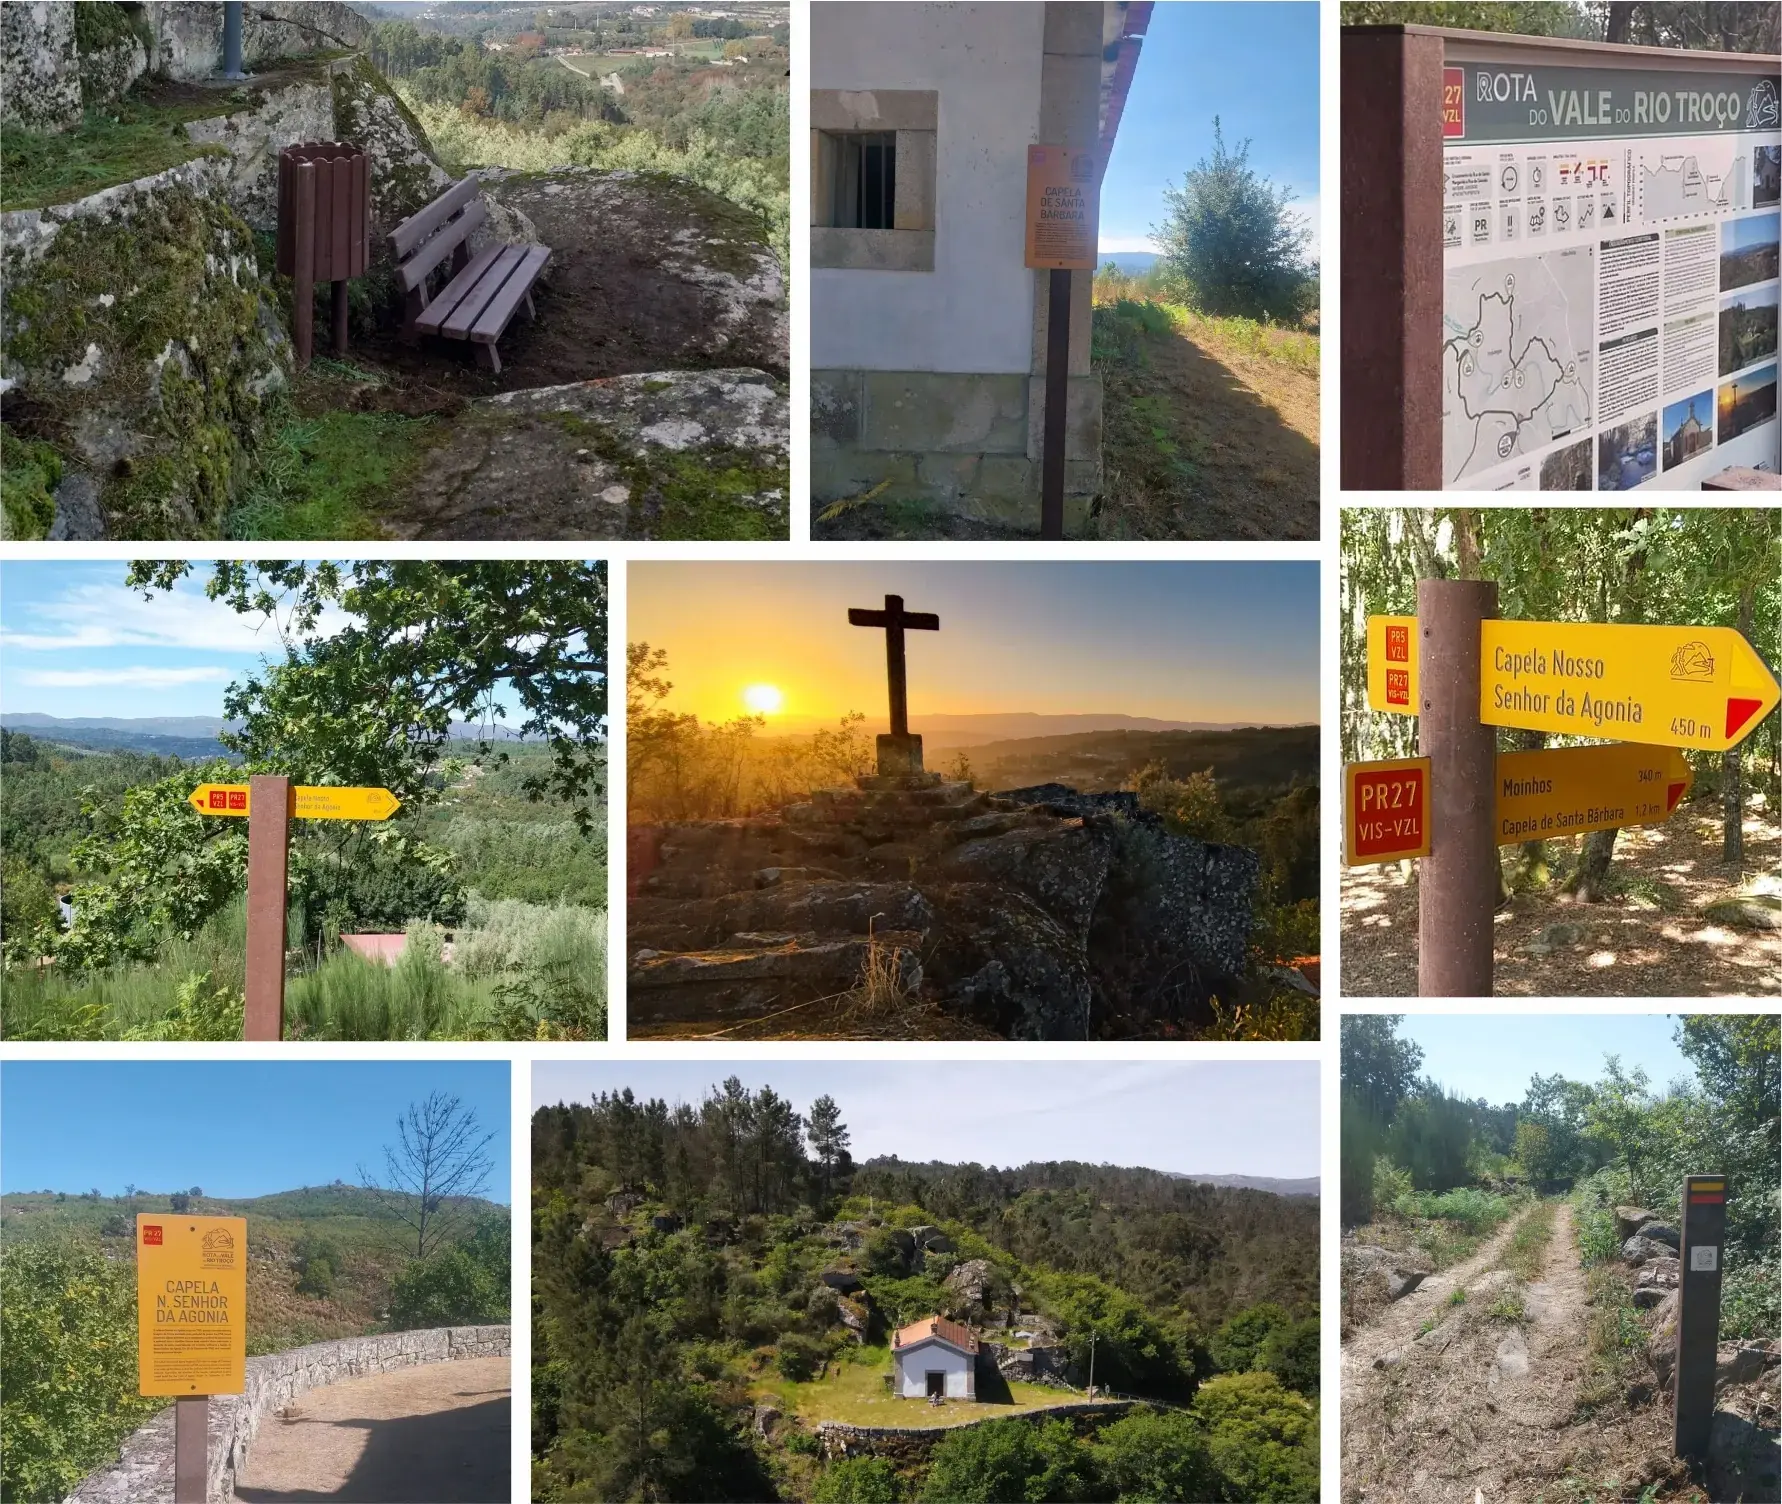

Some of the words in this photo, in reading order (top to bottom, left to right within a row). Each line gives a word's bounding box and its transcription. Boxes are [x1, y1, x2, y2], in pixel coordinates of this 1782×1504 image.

[1476, 71, 1538, 102] ROTA
[1444, 85, 1462, 104] 27
[1529, 109, 1548, 126] DO
[1548, 89, 1612, 126] VALE
[1615, 108, 1631, 124] DO
[1634, 91, 1671, 124] RIO
[1675, 91, 1741, 129] TROÇO
[1045, 185, 1082, 197] CAPELA
[1040, 197, 1054, 208] DE
[1055, 198, 1085, 208] SANTA
[1474, 218, 1488, 232] PR
[1390, 630, 1406, 643] PR5
[1391, 646, 1406, 659] VZL
[1494, 645, 1547, 679] Capela
[1552, 649, 1605, 680] Nosso
[1389, 673, 1408, 687] PR27
[1493, 684, 1551, 715] Senhor
[1555, 689, 1575, 717] da
[1580, 692, 1643, 727] Agonia
[1670, 717, 1695, 738] 450
[1698, 723, 1712, 739] m
[1637, 769, 1653, 783] 340
[1654, 771, 1662, 780] m
[1502, 776, 1552, 798] Moinhos
[230, 793, 245, 801] PR27
[1361, 780, 1417, 812] PR27
[1635, 804, 1648, 819] 1,2
[1648, 803, 1660, 817] km
[1502, 818, 1540, 836] Capela
[1540, 814, 1554, 830] de
[1556, 811, 1585, 829] Santa
[1587, 806, 1625, 825] Bárbara
[1359, 821, 1420, 842] VIS-VZL
[166, 1280, 219, 1294] CAPELA
[157, 1295, 170, 1308] N.
[173, 1295, 228, 1309] SENHOR
[156, 1309, 175, 1323] DA
[178, 1309, 229, 1323] AGONIA
